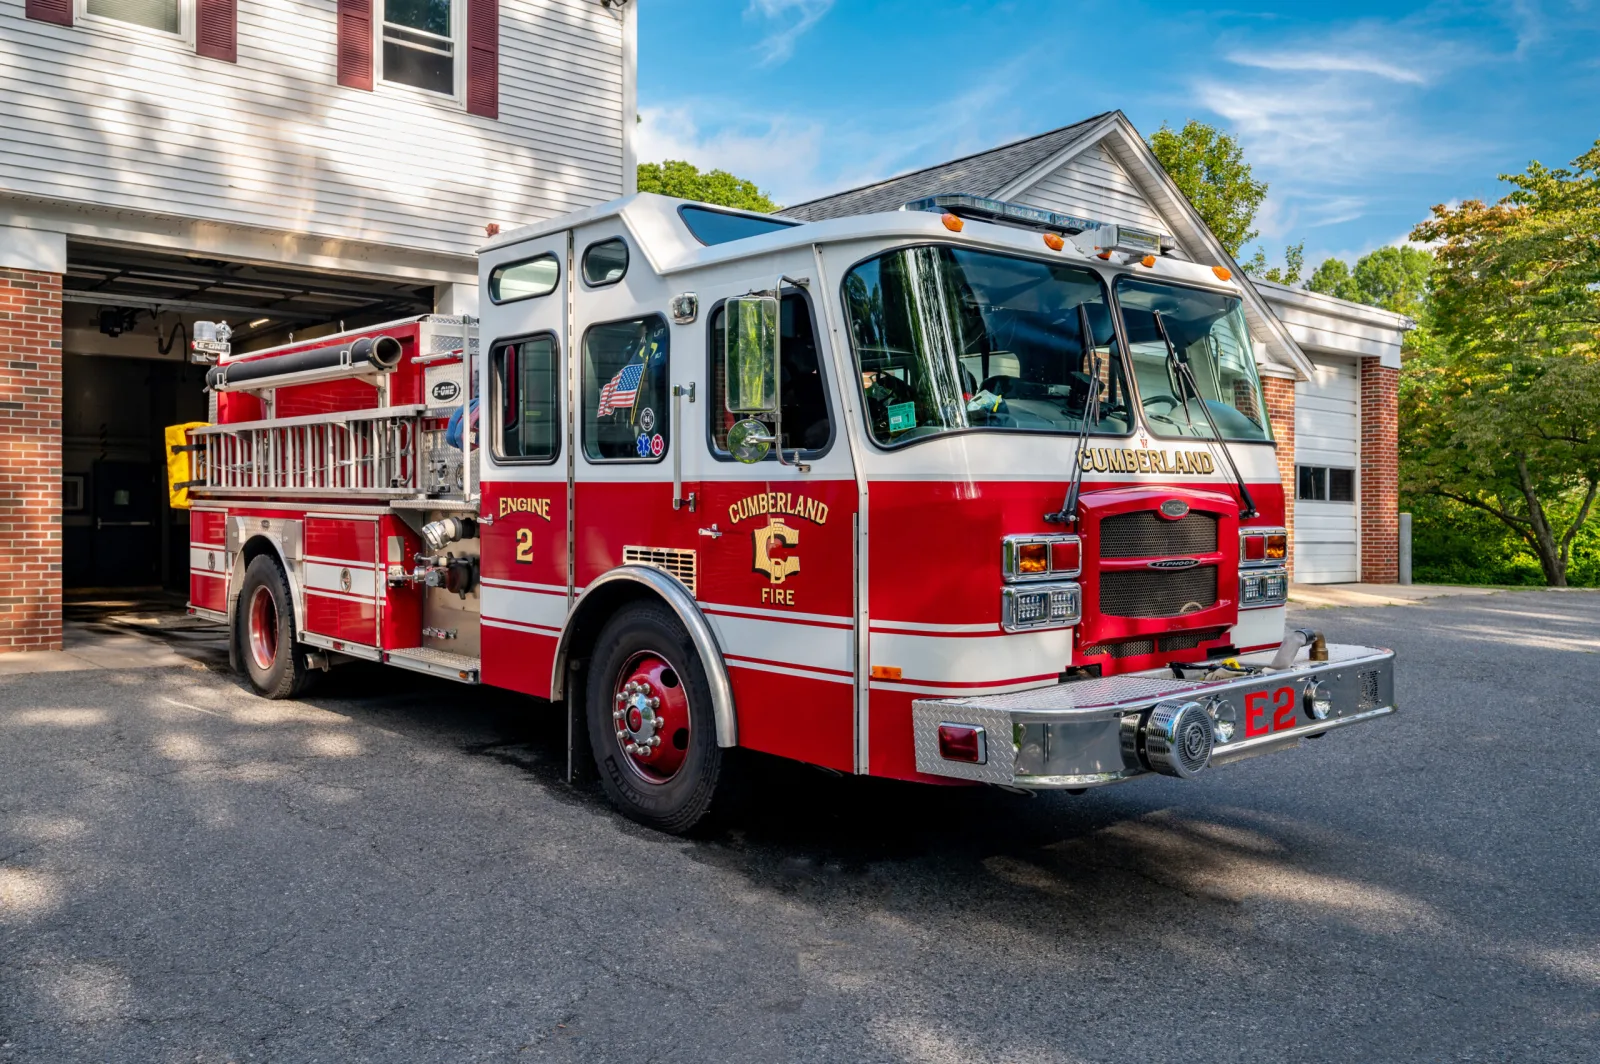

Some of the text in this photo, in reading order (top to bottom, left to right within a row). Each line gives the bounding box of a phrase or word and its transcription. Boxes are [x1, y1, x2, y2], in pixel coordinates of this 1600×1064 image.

[433, 384, 456, 397] E-ONE
[1078, 447, 1215, 474] CUMBERLAND
[498, 497, 551, 521] ENGINE
[728, 491, 829, 525] CUMBERLAND
[515, 527, 534, 564] 2
[761, 587, 795, 605] FIRE
[1245, 686, 1296, 737] E2
[606, 760, 656, 810] MICHELIN
